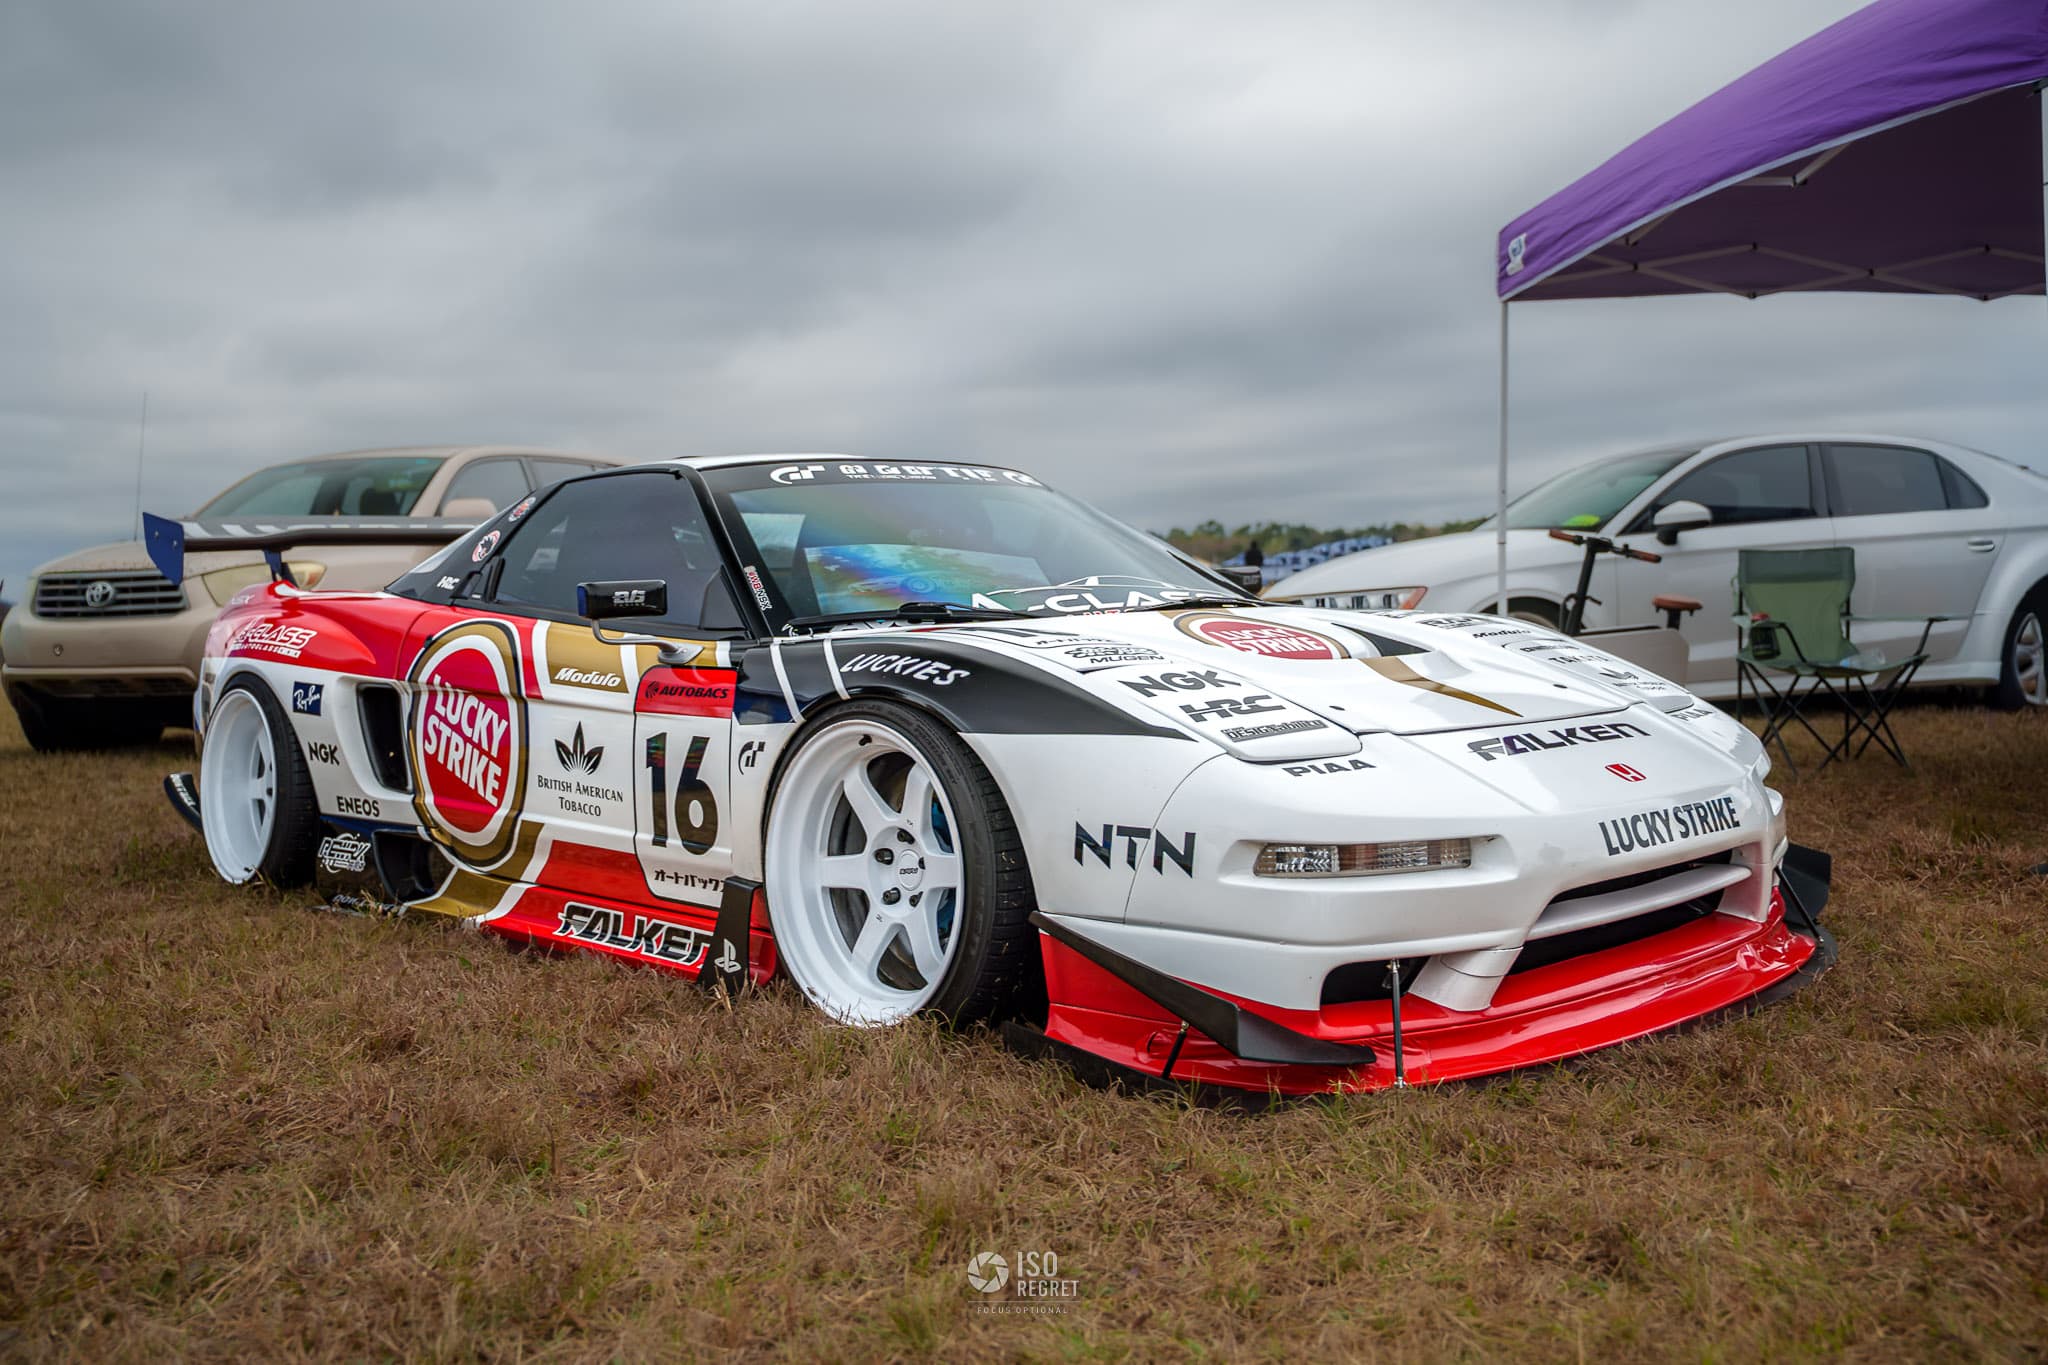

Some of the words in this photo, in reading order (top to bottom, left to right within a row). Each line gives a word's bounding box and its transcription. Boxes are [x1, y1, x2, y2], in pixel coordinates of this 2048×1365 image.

[1208, 628, 1298, 641] LUCKY
[1231, 636, 1328, 654] STRIKE
[840, 654, 970, 687] LUCKIES
[1090, 655, 1165, 664] MUGEN
[555, 667, 622, 688] Modulo
[1117, 669, 1242, 698] NGK
[659, 684, 731, 700] AUTOBACS
[433, 674, 508, 758] LUCKY
[1179, 695, 1287, 722] HRC
[308, 741, 341, 766] NGK
[1467, 722, 1652, 761] FALKEN
[424, 714, 502, 807] STRIKE
[1282, 759, 1377, 777] PIAA
[537, 774, 573, 794] BRITISH
[575, 781, 624, 803] AMERICAN
[646, 731, 719, 855] 16
[336, 796, 381, 818] ENEOS
[558, 796, 602, 817] TOBACCO
[1599, 808, 1674, 857] LUCKY
[1674, 796, 1741, 840] STRIKE
[1074, 821, 1196, 878] NTN
